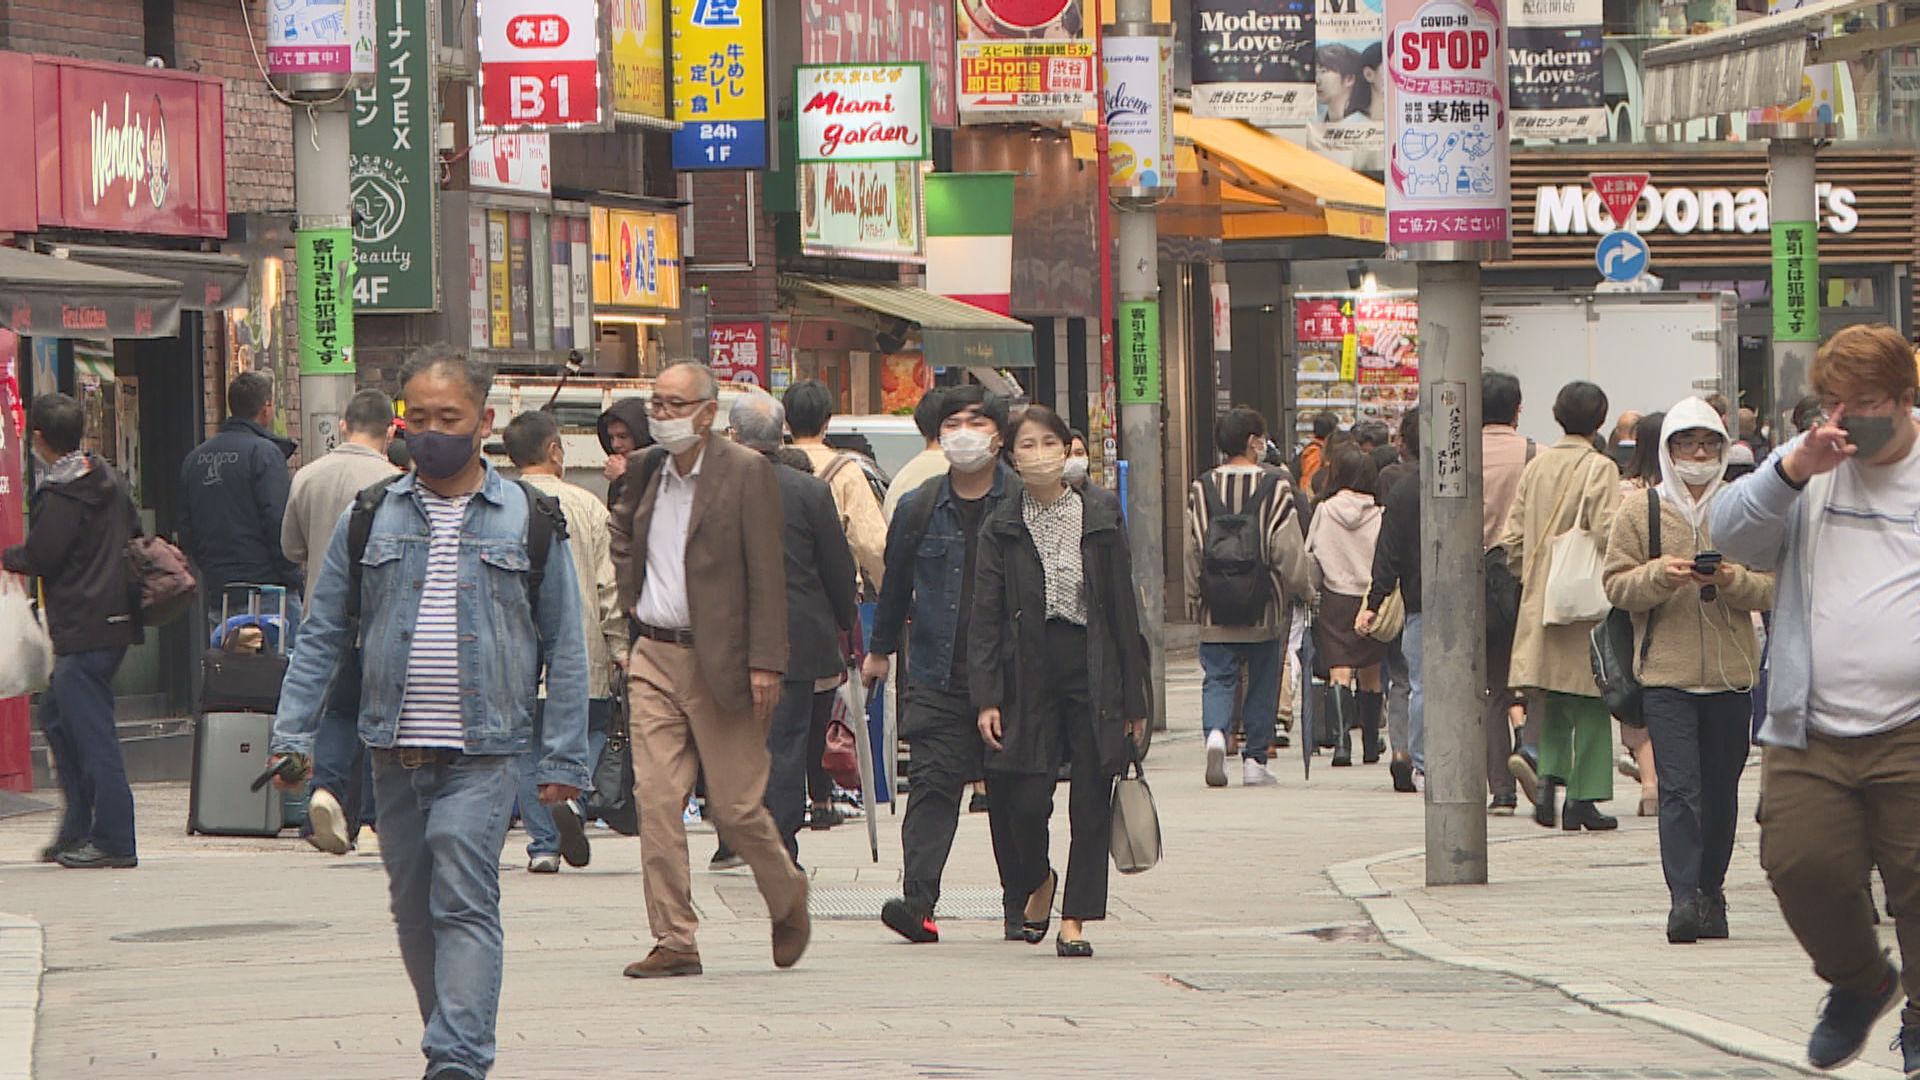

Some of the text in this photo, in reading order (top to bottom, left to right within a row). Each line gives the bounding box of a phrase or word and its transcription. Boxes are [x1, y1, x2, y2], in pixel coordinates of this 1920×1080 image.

[514, 18, 560, 43] 本店
[1200, 11, 1302, 31] Modern
[1420, 15, 1469, 28] COVID-19
[1221, 32, 1283, 51] Love
[1402, 30, 1489, 71] STOP
[967, 58, 1041, 75] iPhone
[1053, 60, 1081, 75] 渋谷
[1508, 48, 1591, 66] Modern
[709, 52, 725, 105] カレー
[727, 43, 745, 97] 牛めし
[1525, 66, 1576, 83] Love
[509, 74, 570, 119] B1
[690, 65, 708, 113] 定食
[803, 90, 895, 115] Miami
[1427, 100, 1489, 123] 実施中
[700, 124, 737, 139] 24h
[90, 91, 144, 208] Wendy's
[705, 145, 731, 162] 1F
[1533, 182, 1859, 234] McDona's
[1609, 194, 1634, 206] STOP
[1398, 215, 1501, 234] ご協力ください!
[352, 276, 389, 304] 4F
[1785, 228, 1806, 334] 客引きは犯罪です
[312, 237, 338, 365] 客引きは犯罪です
[1131, 307, 1148, 397] 客引きは犯罪です
